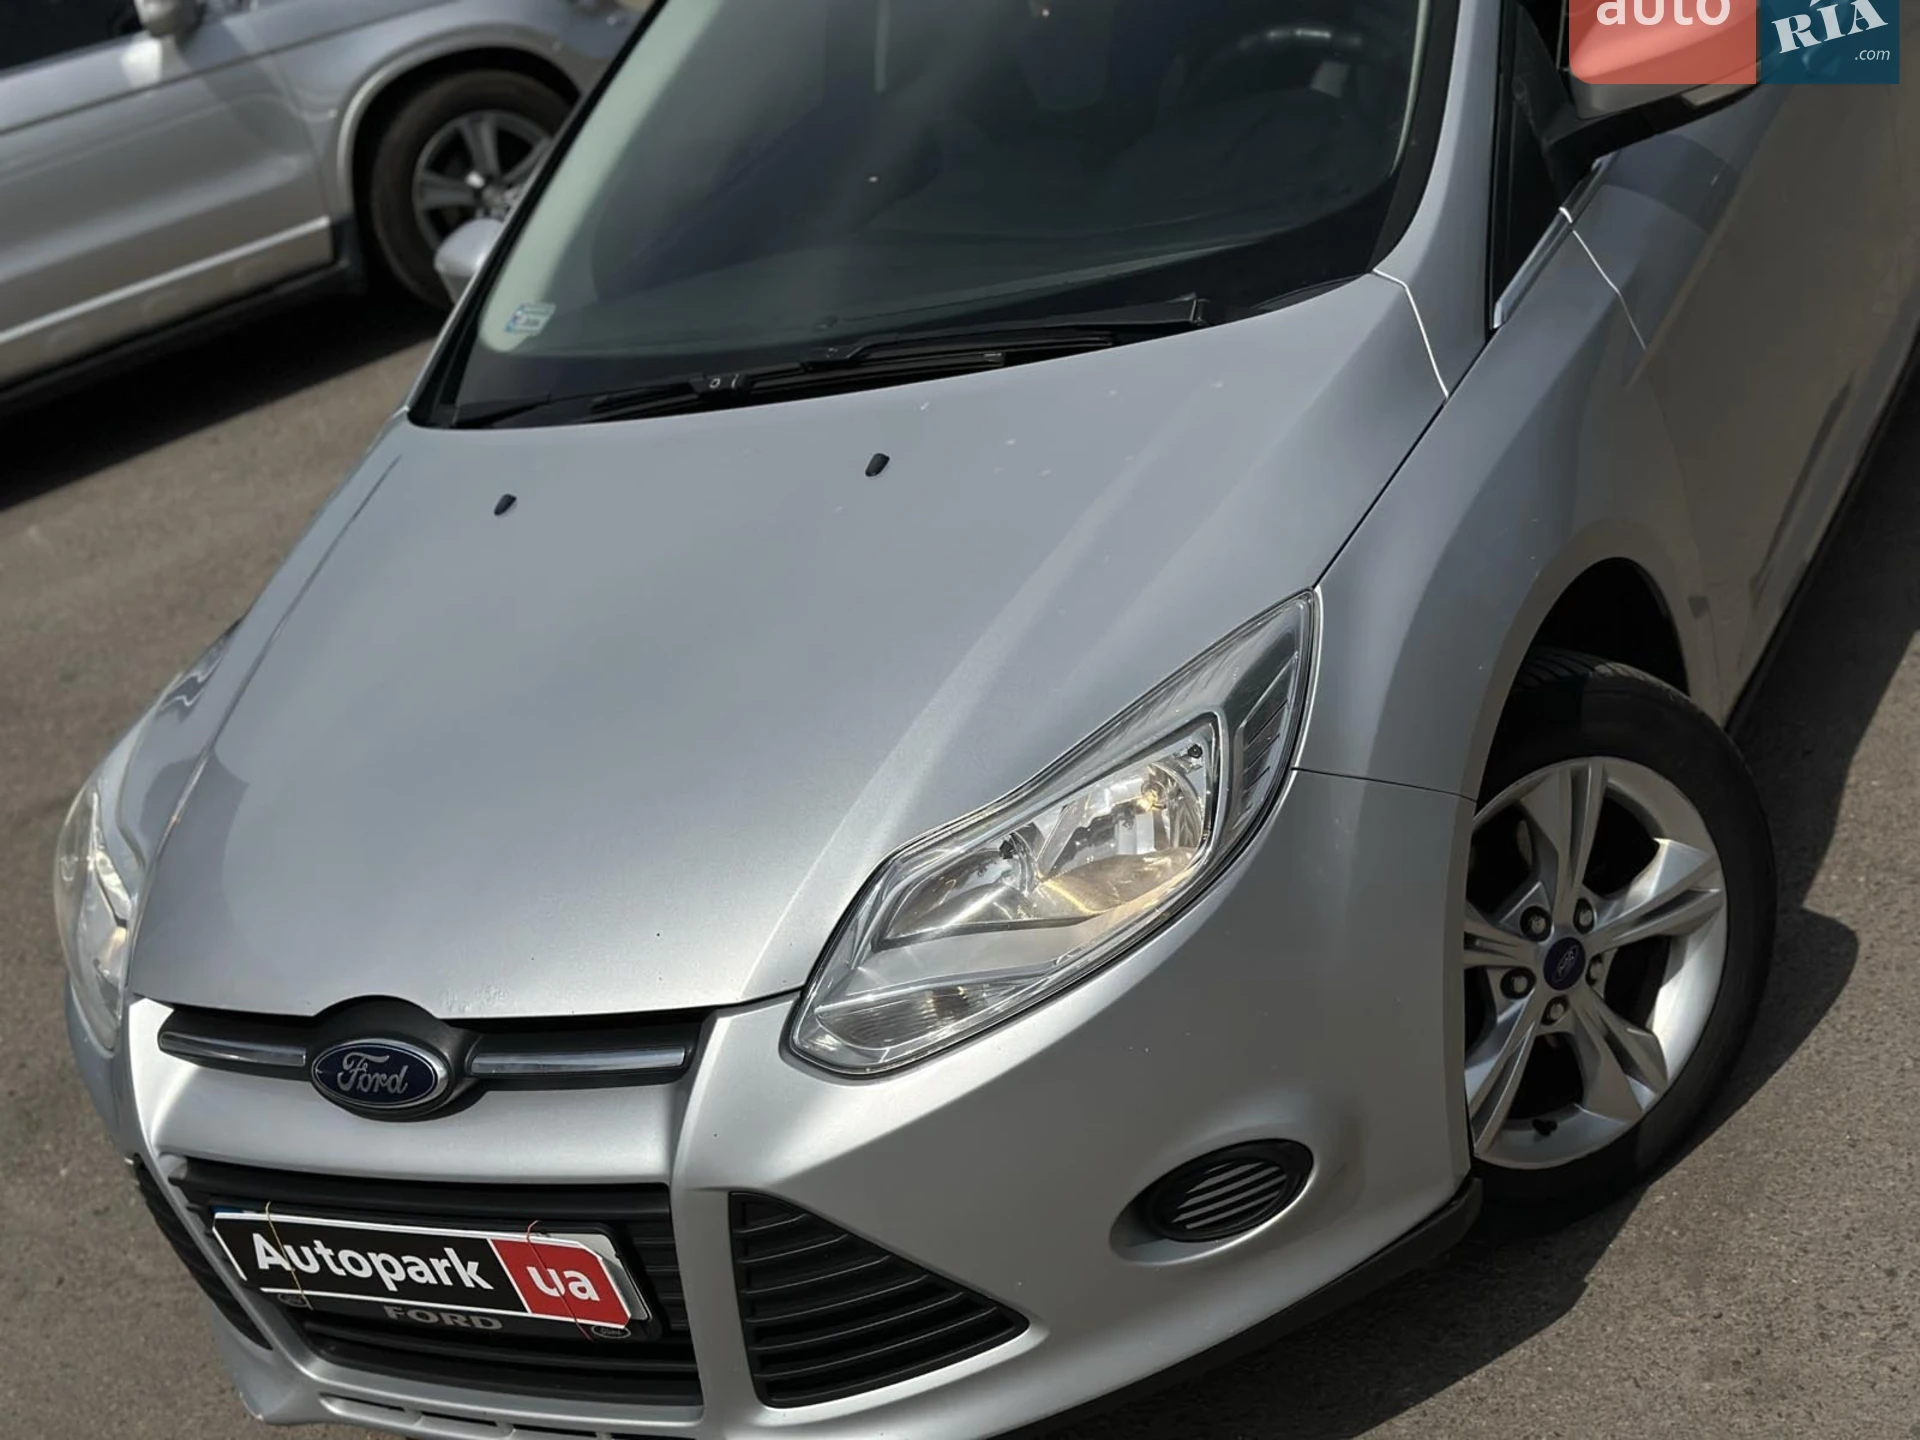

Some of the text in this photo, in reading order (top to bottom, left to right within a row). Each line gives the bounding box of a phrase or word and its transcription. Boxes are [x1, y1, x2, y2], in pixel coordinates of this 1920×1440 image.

[337, 1052, 409, 1094] Ford
[252, 1232, 601, 1301] Autopark ua
[383, 1304, 503, 1331] FORD
